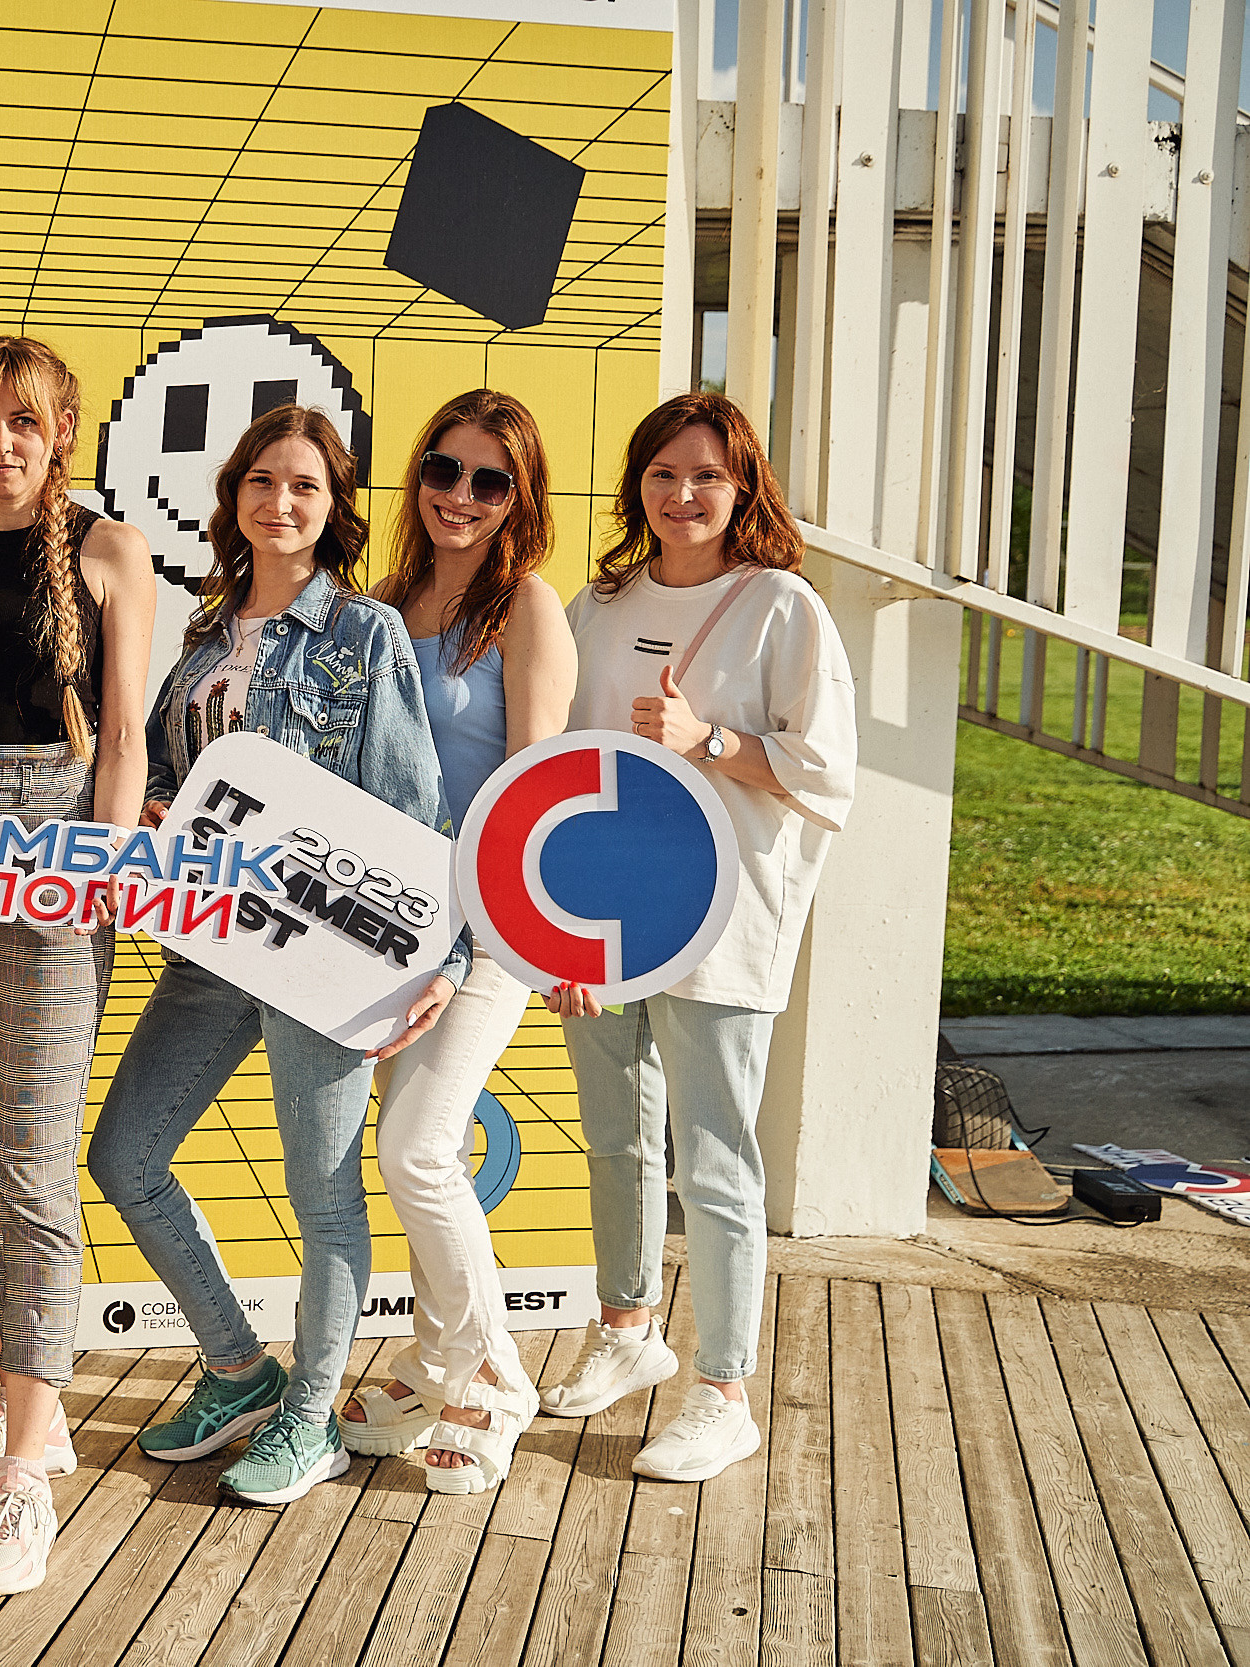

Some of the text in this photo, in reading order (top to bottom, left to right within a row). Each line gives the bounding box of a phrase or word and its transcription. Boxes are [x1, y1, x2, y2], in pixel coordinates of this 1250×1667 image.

[204, 778, 266, 827] IT
[288, 827, 440, 929] 2023
[503, 1290, 568, 1311] EST
